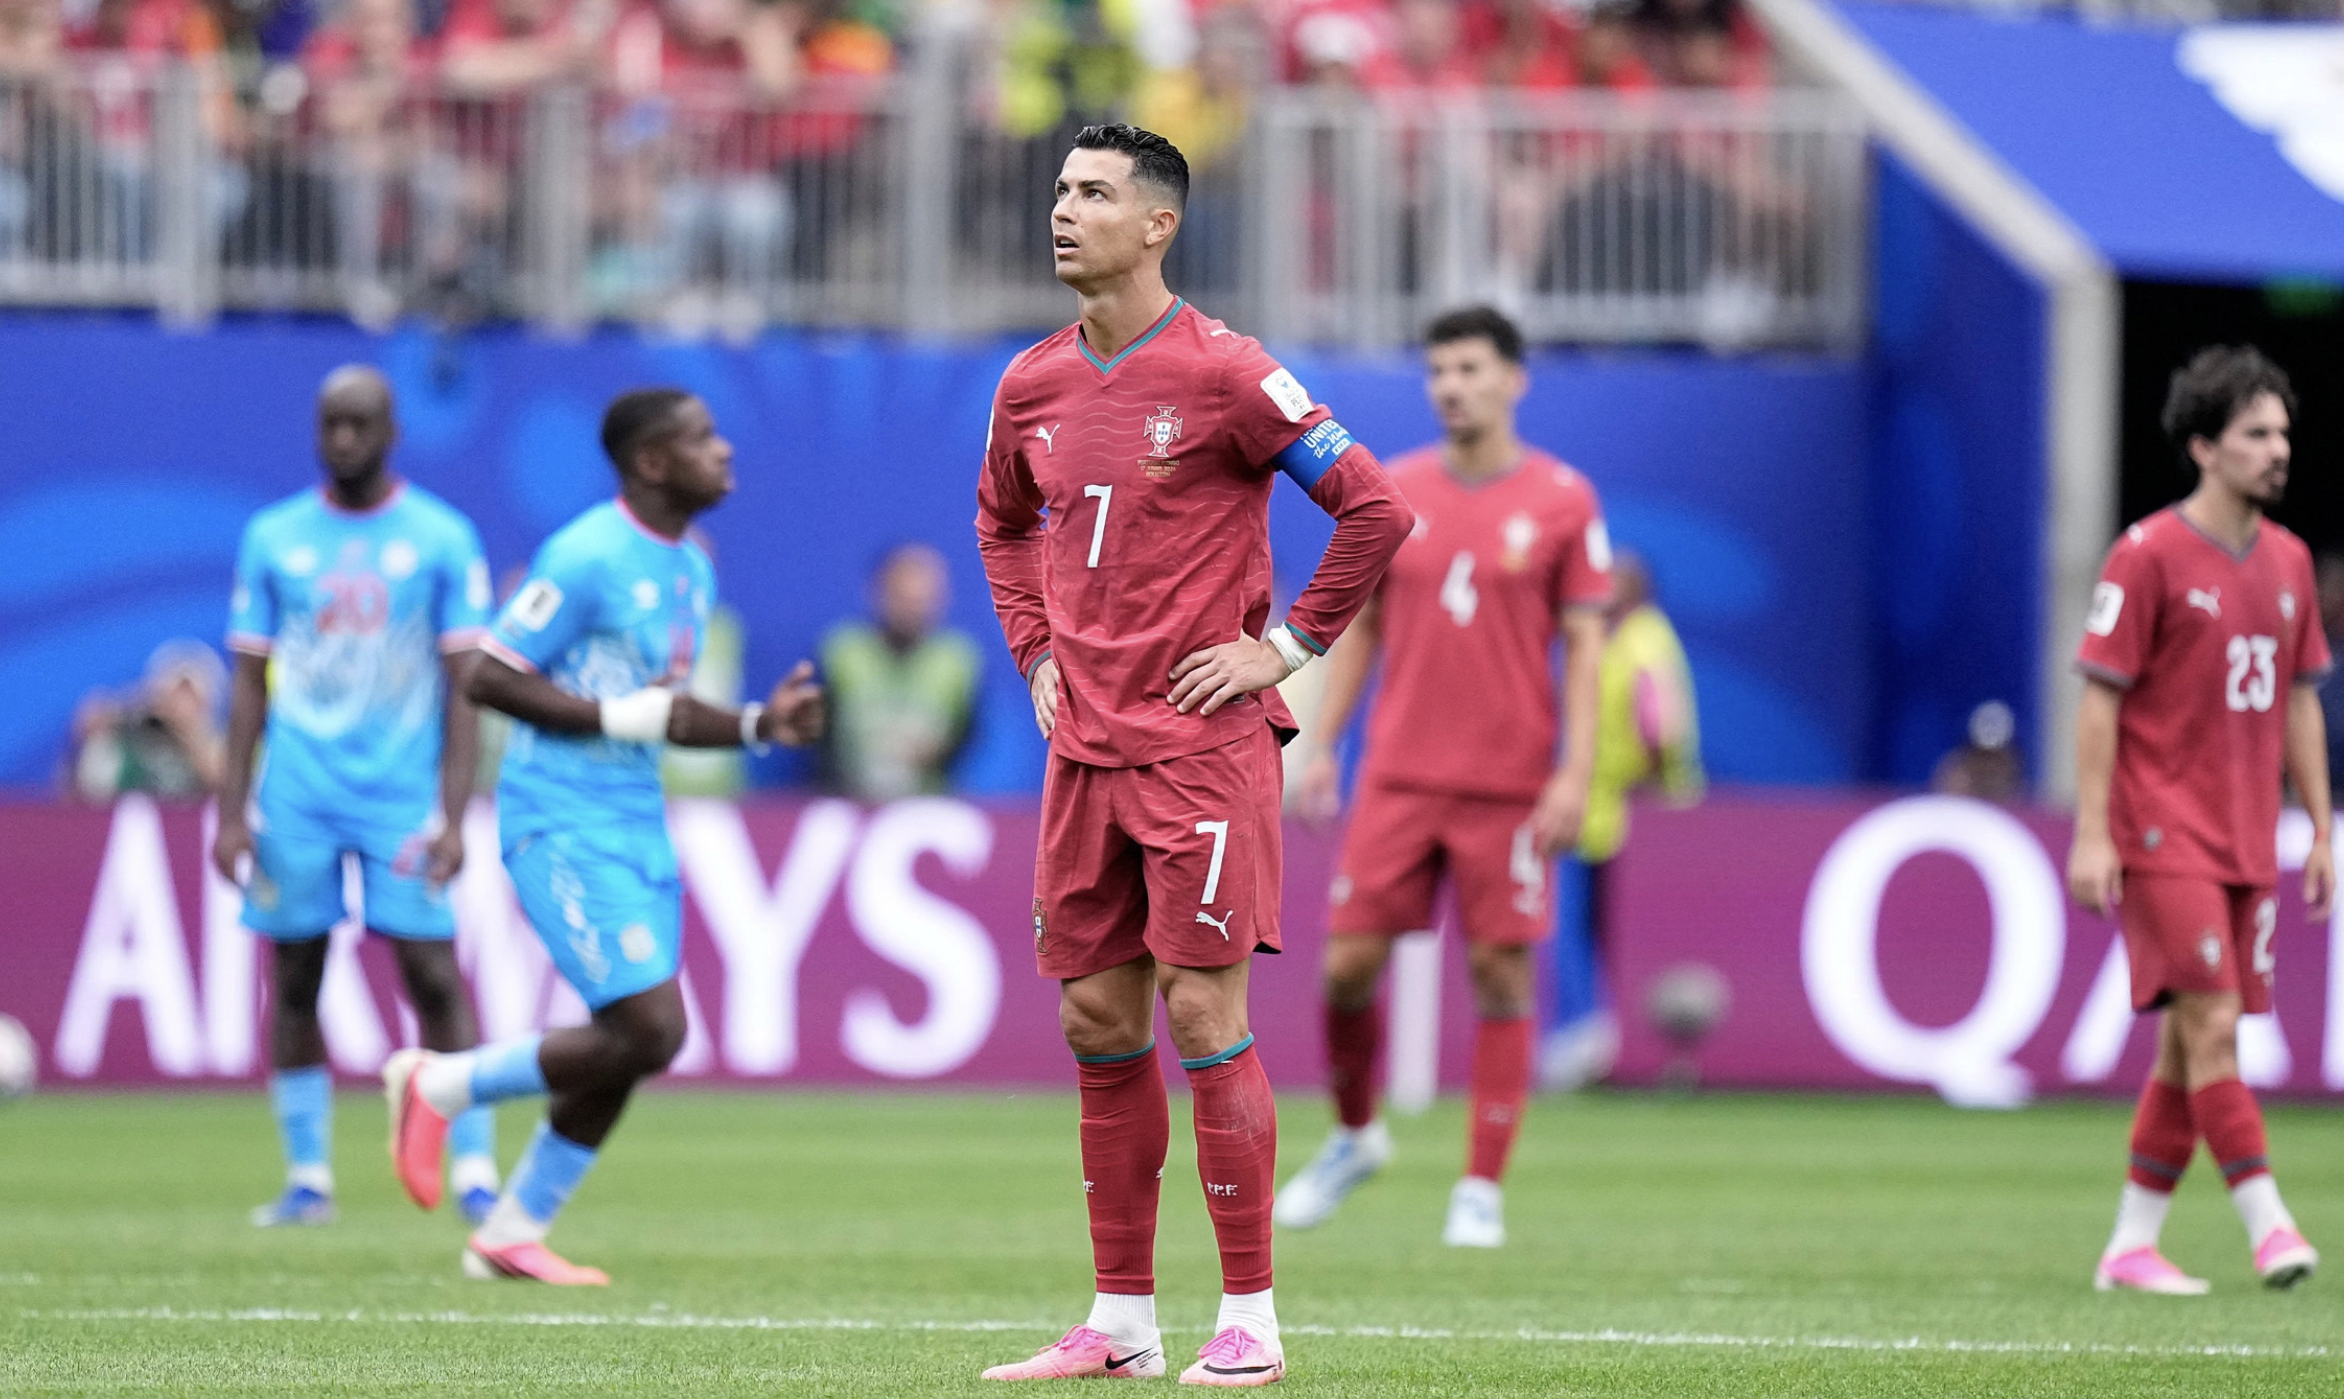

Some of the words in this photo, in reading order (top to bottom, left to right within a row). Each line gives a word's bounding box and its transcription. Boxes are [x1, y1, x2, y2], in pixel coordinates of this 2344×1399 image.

[1313, 442, 1330, 459] the
[1083, 484, 1113, 568] 7
[315, 569, 389, 637] 20
[1439, 549, 1480, 629] 4
[2226, 634, 2278, 712] 23
[1195, 819, 1229, 905] 7
[53, 794, 1001, 1078] AIYS
